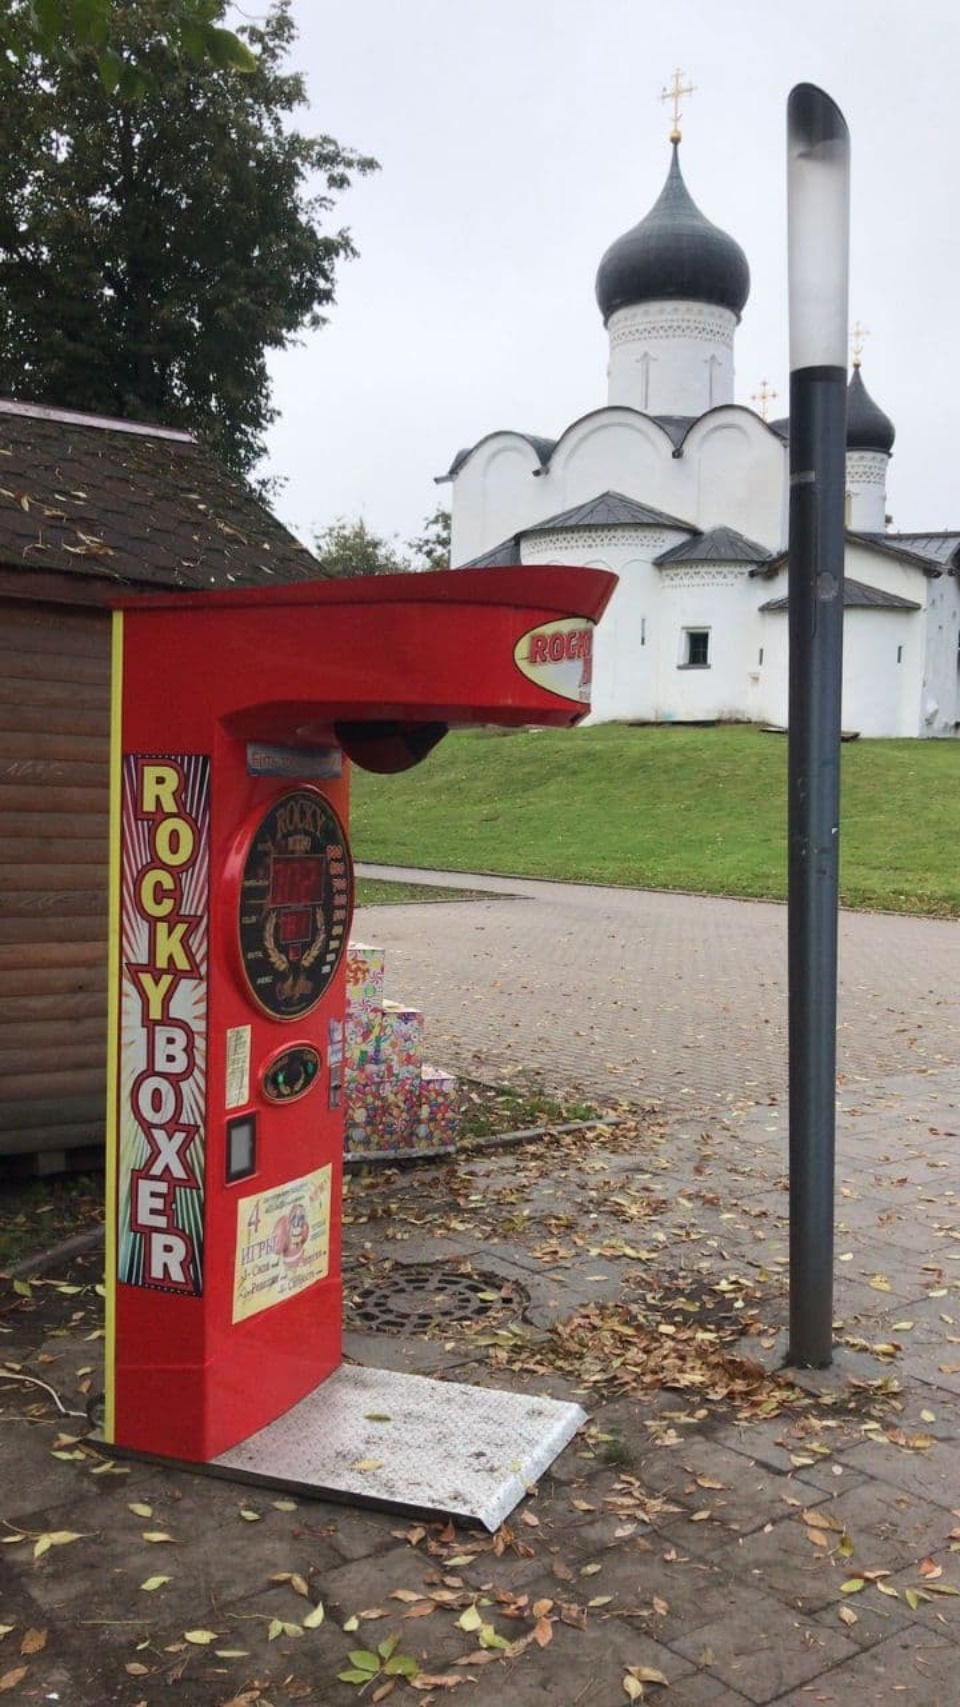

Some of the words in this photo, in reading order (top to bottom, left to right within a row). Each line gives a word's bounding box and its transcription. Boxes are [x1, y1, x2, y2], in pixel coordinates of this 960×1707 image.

[138, 763, 197, 1022] ROCKY
[134, 1021, 194, 1286] BOXER
[248, 1199, 261, 1233] 4
[241, 1235, 277, 1266] ИГРЫ
